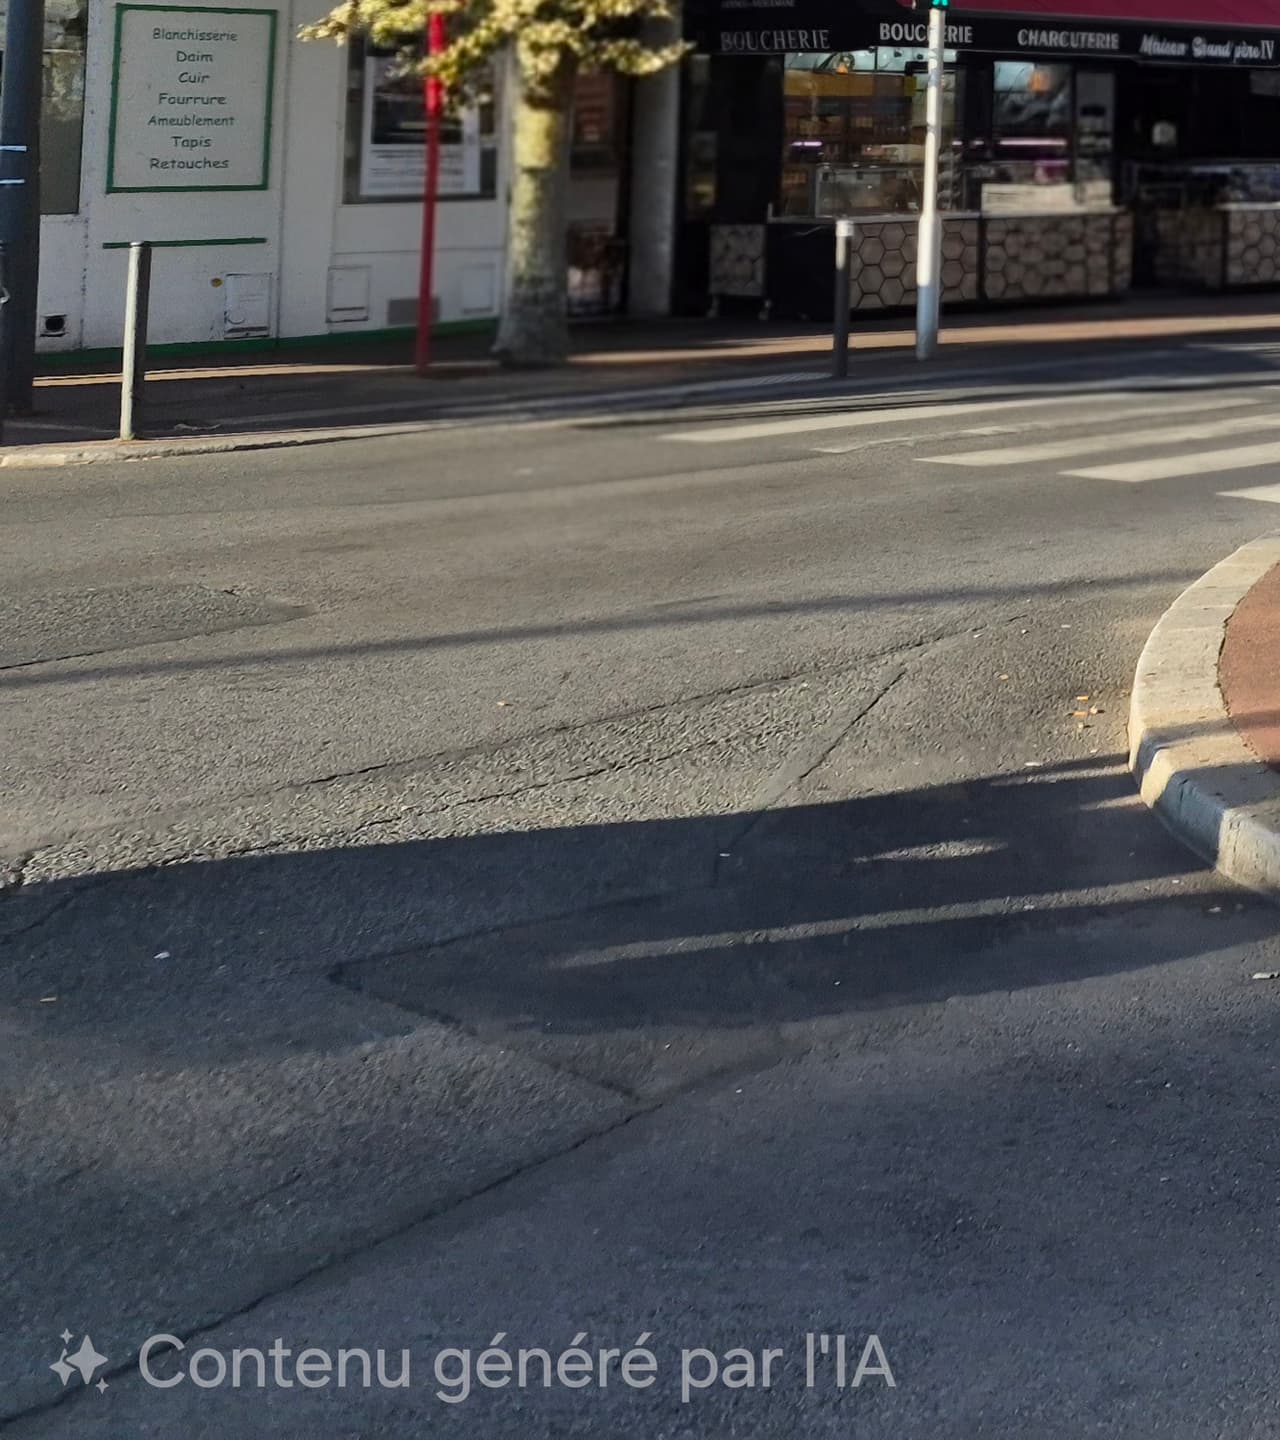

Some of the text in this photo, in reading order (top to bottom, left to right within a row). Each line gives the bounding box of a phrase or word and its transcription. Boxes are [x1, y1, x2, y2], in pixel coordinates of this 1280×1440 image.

[152, 27, 238, 42] Blanchisserie
[720, 29, 831, 53] BOUCHERIE
[879, 23, 974, 44] BOUCRIE
[1017, 28, 1120, 50] CHARCUTERIE
[176, 50, 214, 63] Daim
[178, 71, 210, 84] Cuir
[159, 92, 227, 105] Fourrure
[148, 114, 235, 127] Ameublement
[171, 136, 212, 151] Tapis
[150, 157, 230, 170] Retouches
